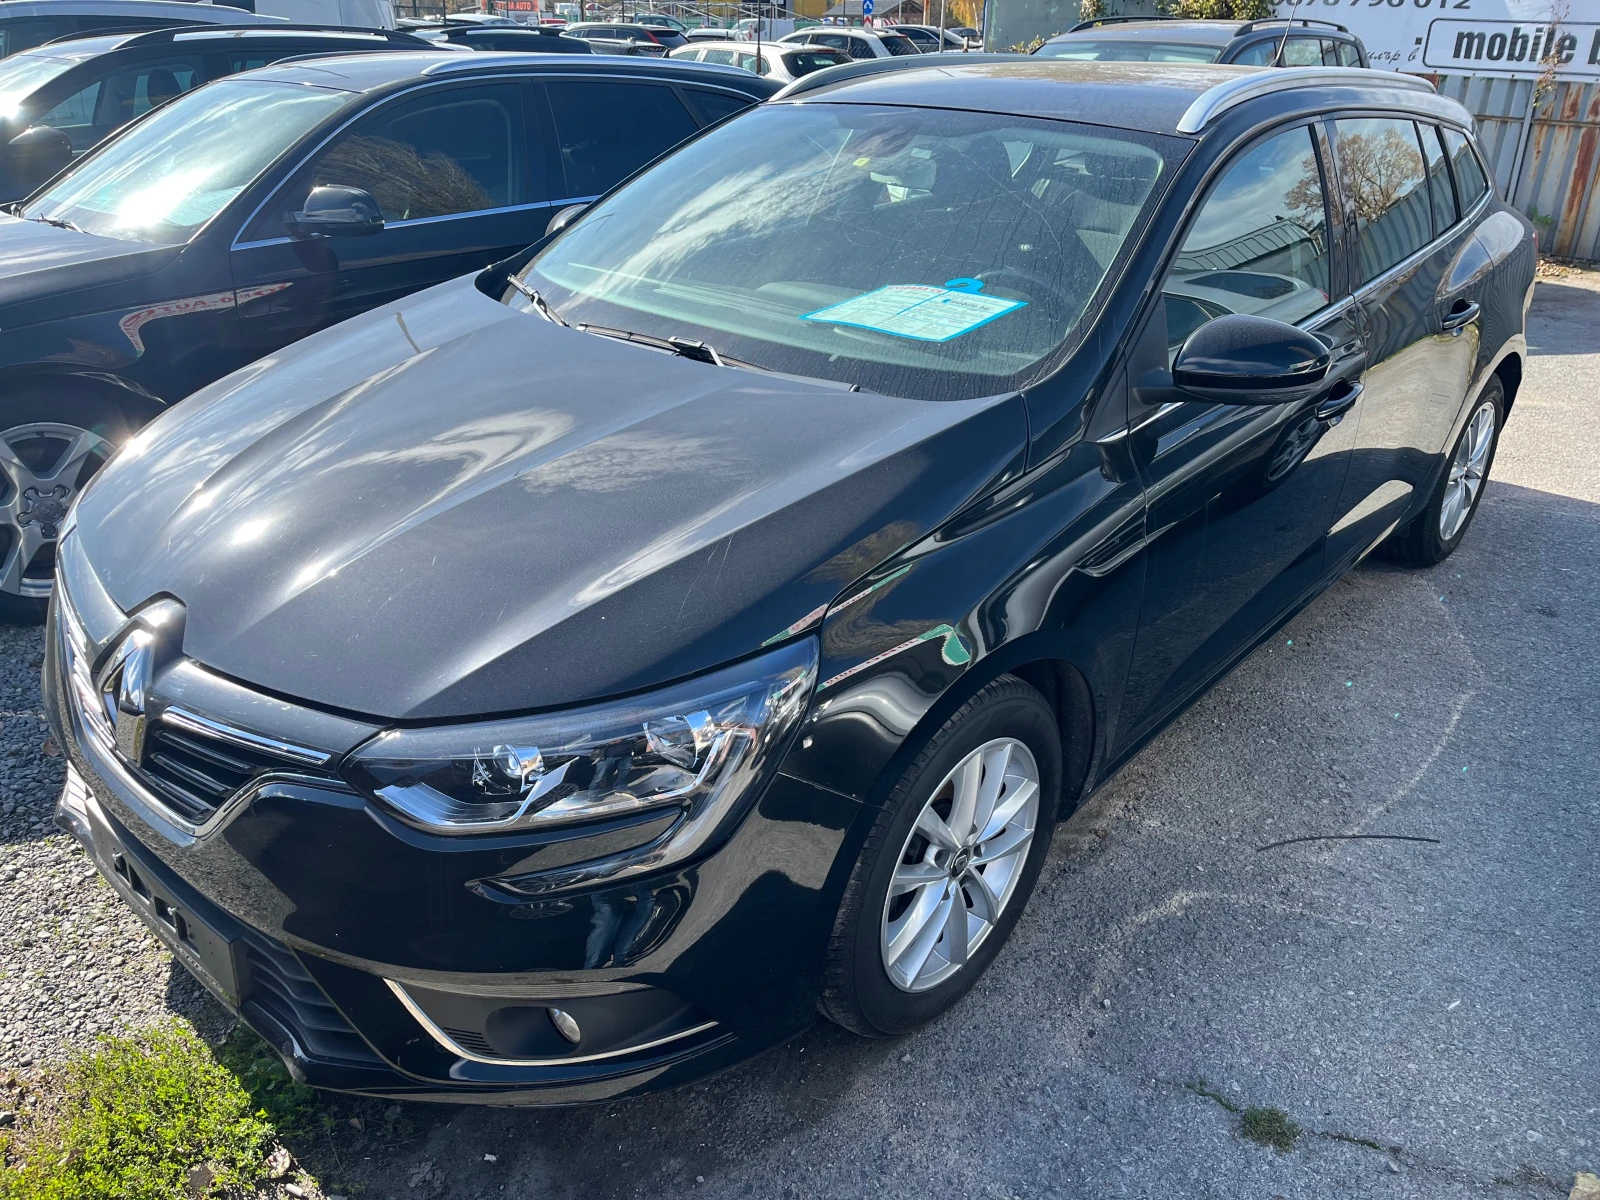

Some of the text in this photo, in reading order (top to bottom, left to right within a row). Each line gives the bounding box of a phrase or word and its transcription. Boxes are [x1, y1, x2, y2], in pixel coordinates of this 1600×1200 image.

[515, 1, 532, 10] AUTO
[1453, 25, 1578, 64] mobile
[1366, 50, 1401, 64] илър
